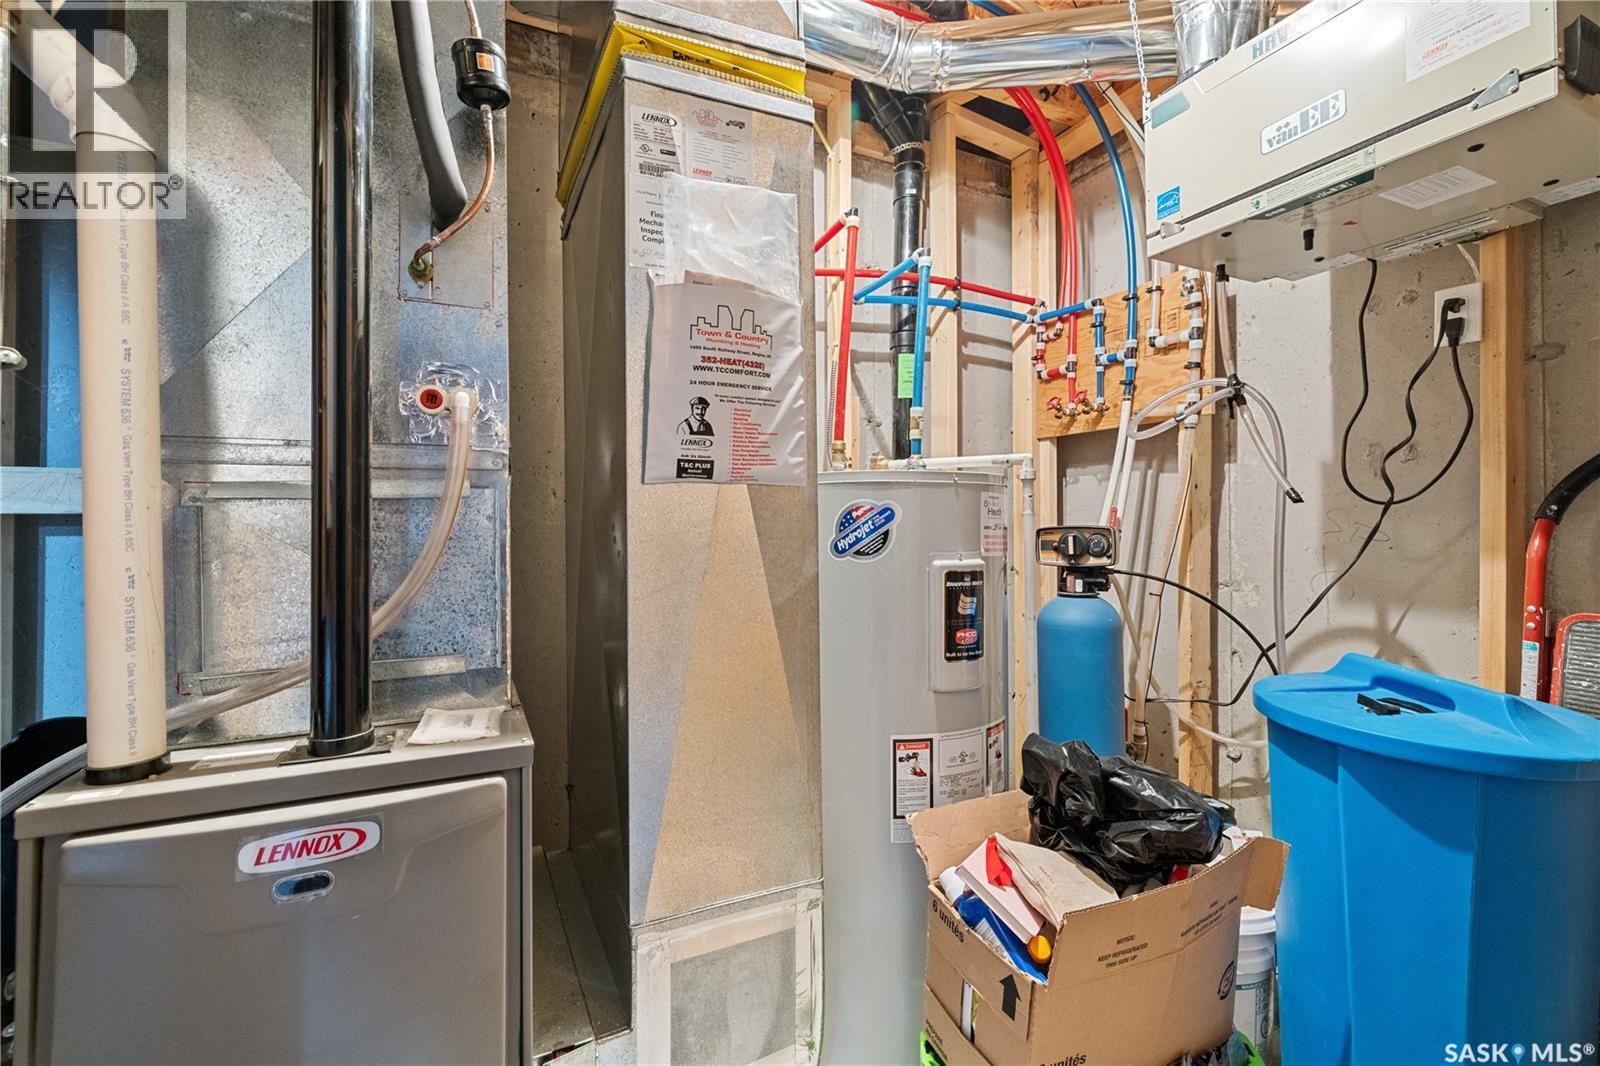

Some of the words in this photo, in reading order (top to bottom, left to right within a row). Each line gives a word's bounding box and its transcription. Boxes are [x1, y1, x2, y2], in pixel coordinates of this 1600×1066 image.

[642, 112, 670, 126] LENNOX
[695, 328, 721, 337] Town
[735, 332, 769, 345] Country
[693, 365, 771, 379] WWW.TCCOMFORT.COM
[119, 368, 132, 407] SYSTEM
[717, 382, 750, 390] EMERGENCY
[681, 438, 706, 447] LENNOX
[121, 470, 133, 489] Type
[124, 502, 134, 523] Class
[837, 518, 875, 551] Hydrojet
[124, 596, 136, 635] SYSTEM
[126, 698, 137, 716] Type
[254, 832, 346, 866] LENNOX
[939, 909, 965, 943] unités
